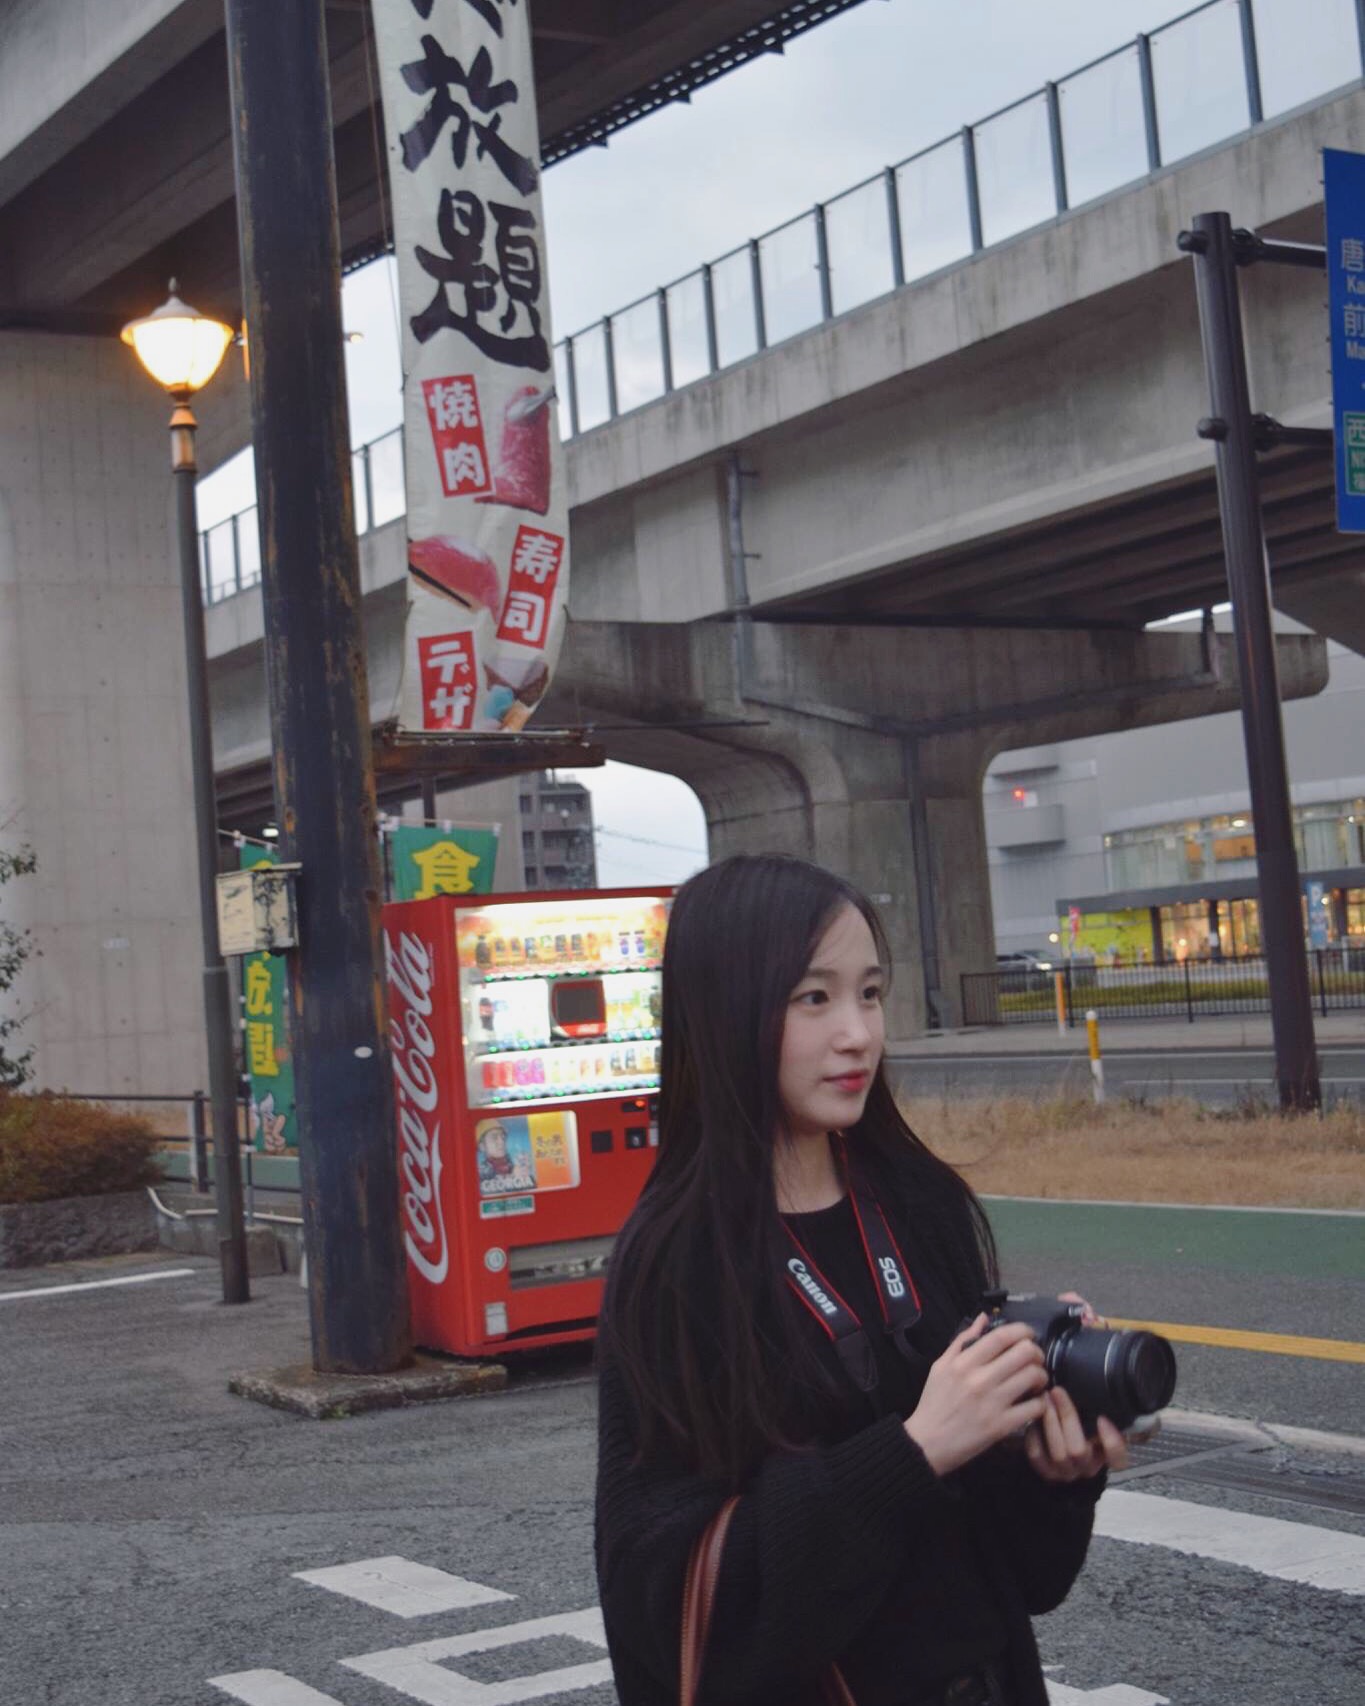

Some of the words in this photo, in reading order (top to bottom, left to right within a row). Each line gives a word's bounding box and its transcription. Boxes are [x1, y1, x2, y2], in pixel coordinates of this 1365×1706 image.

[429, 380, 486, 491] 焼肉
[503, 533, 559, 642] 寿司
[787, 1258, 838, 1315] Canon
[878, 1257, 905, 1298] EOS
